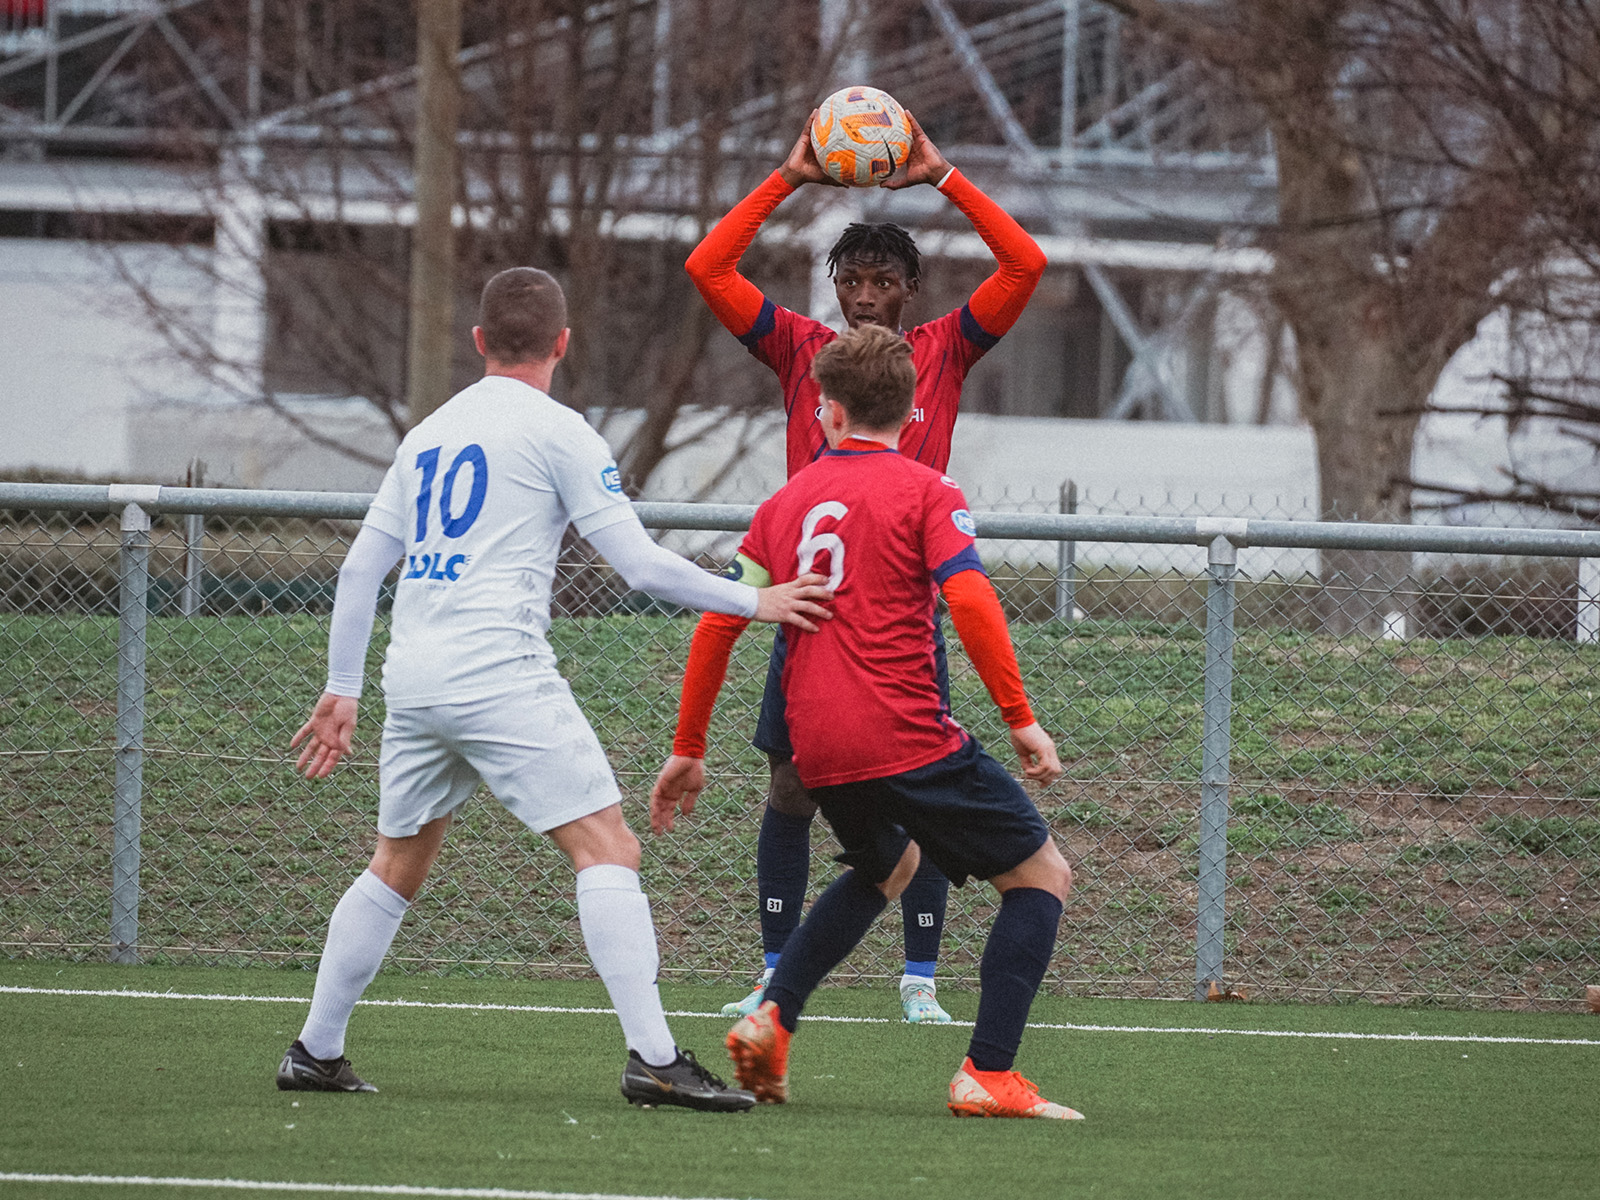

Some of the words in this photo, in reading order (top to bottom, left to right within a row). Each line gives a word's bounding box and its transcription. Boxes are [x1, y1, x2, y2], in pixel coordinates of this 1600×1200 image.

[414, 443, 489, 543] 10
[796, 500, 848, 593] 6
[768, 900, 781, 911] 31
[920, 914, 932, 926] 31
